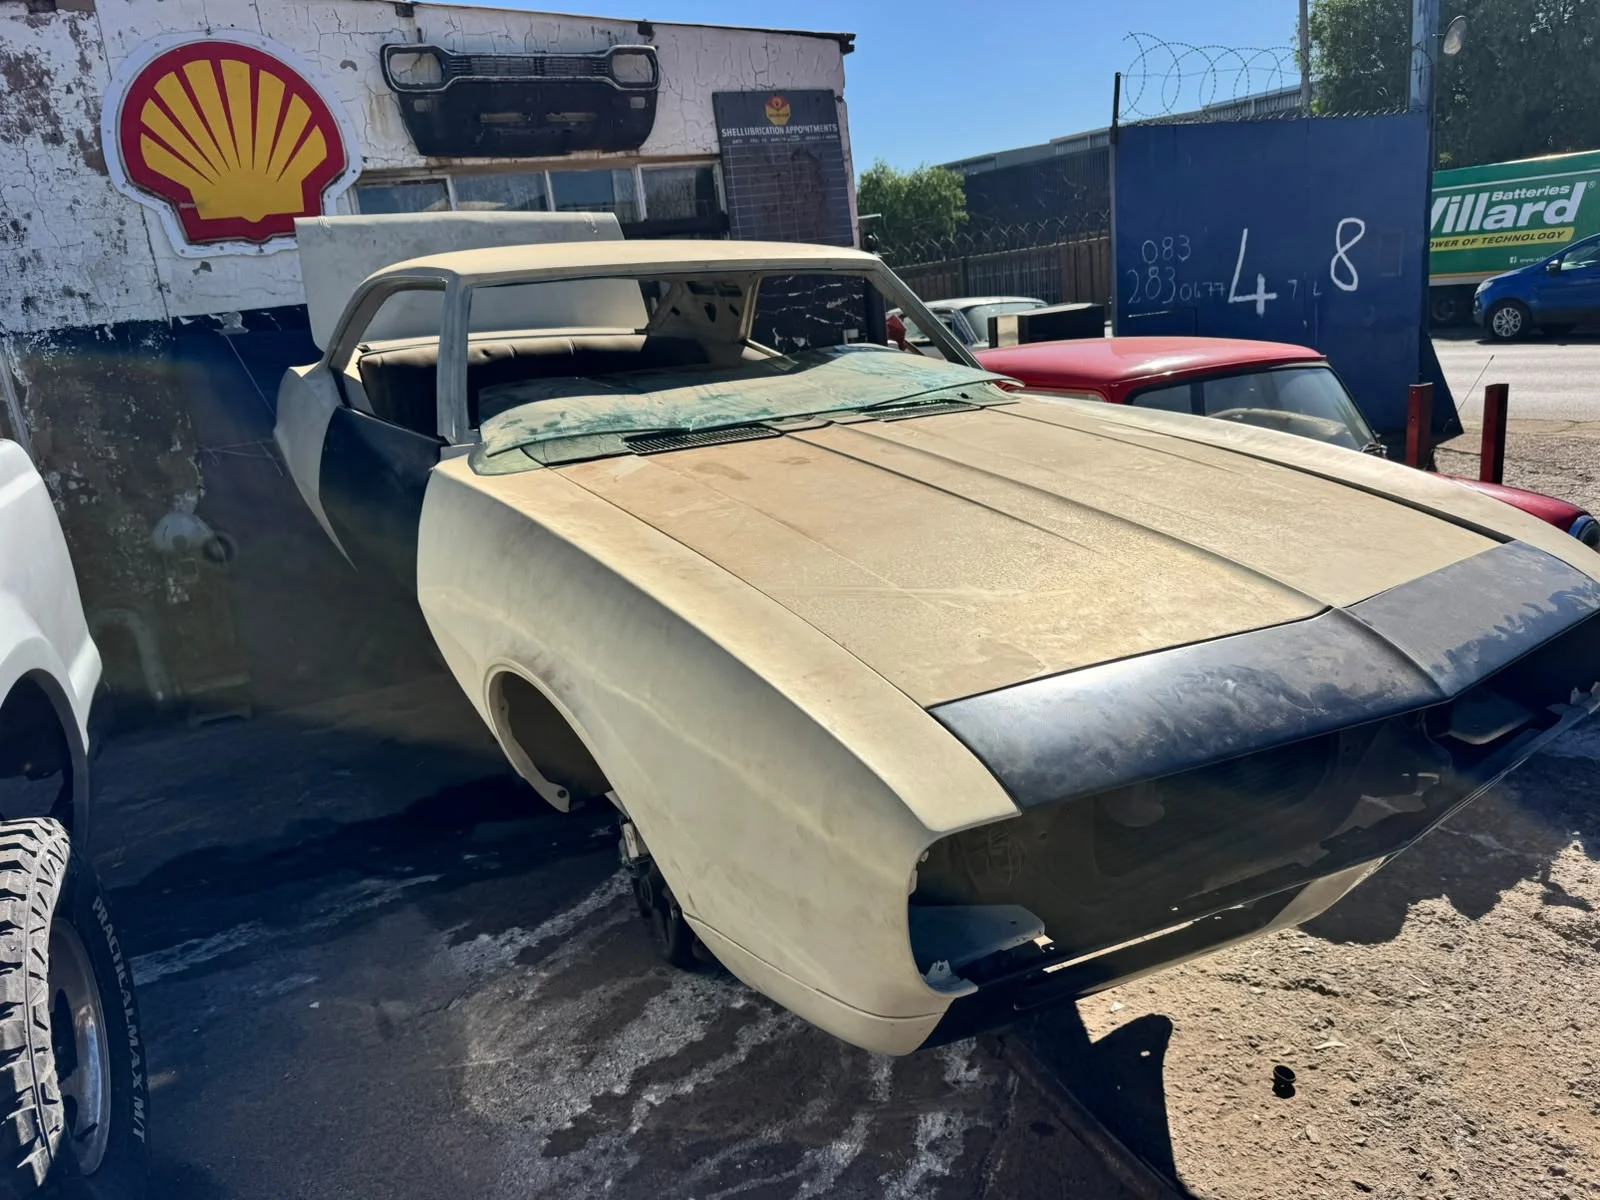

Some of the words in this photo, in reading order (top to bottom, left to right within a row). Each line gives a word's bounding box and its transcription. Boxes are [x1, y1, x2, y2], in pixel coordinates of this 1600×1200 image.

[785, 123, 838, 135] APPOINTMENTS
[1491, 185, 1571, 202] Batteries
[1141, 234, 1192, 264] 083
[1462, 237, 1481, 247] OF
[1481, 230, 1567, 246] TECHNOLOGY
[1330, 217, 1366, 292] 8
[1227, 228, 1279, 318] 4
